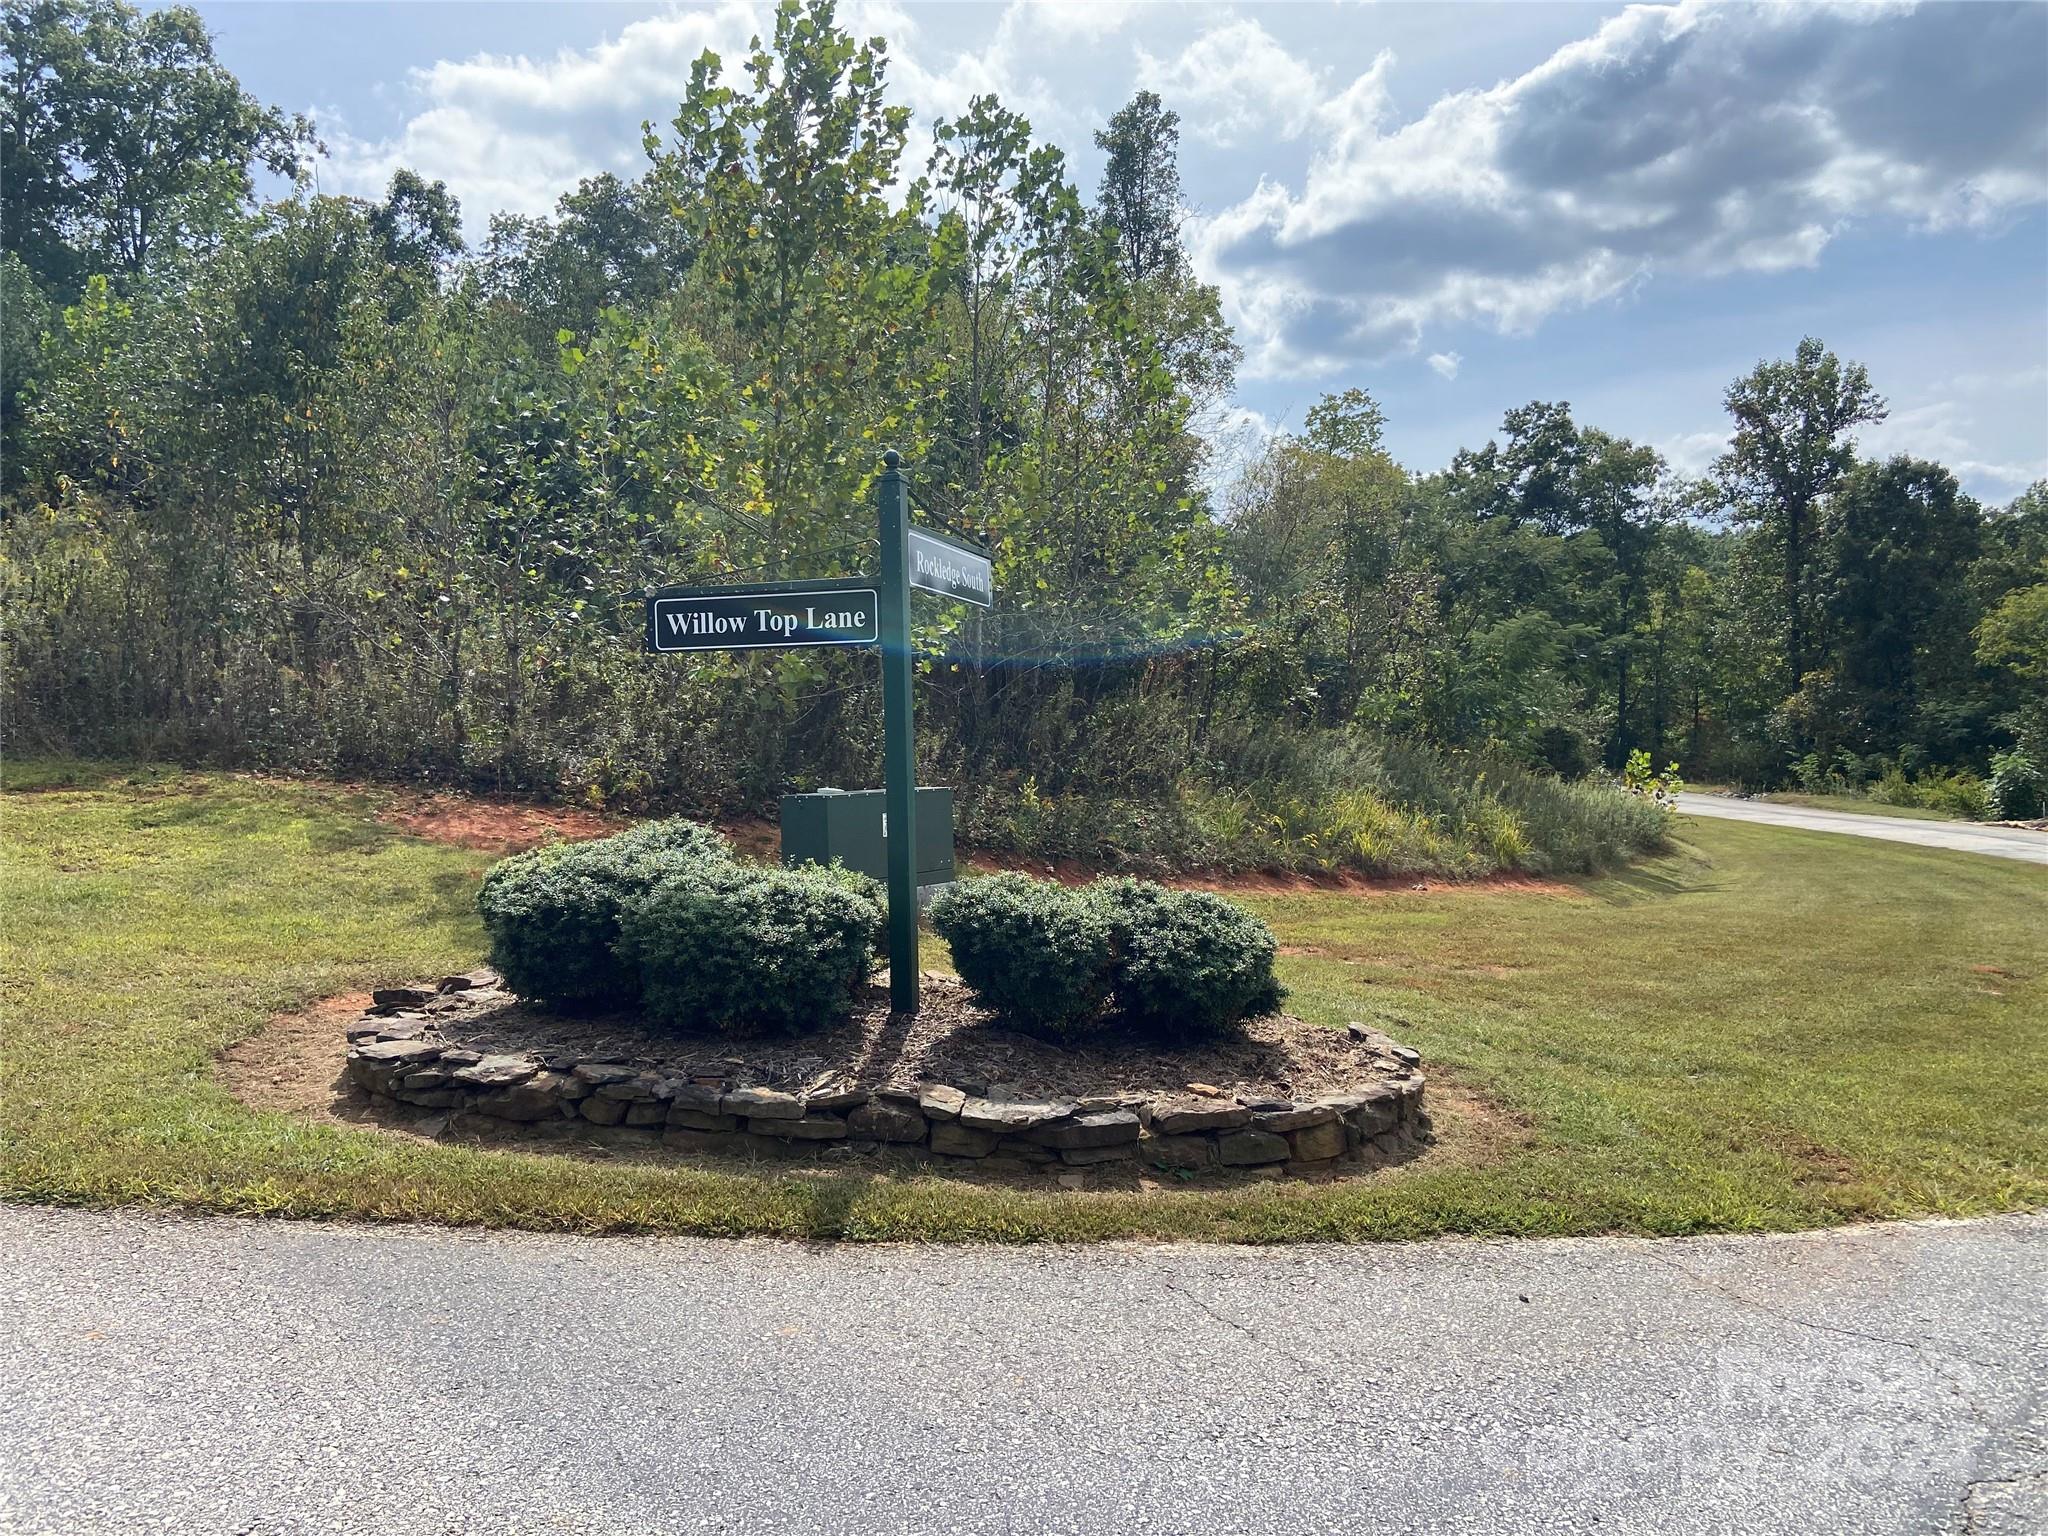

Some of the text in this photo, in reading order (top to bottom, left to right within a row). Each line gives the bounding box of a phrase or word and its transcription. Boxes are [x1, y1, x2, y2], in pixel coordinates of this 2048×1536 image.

[916, 551, 984, 592] Rockledge South
[666, 607, 866, 637] Willow Top Lane
